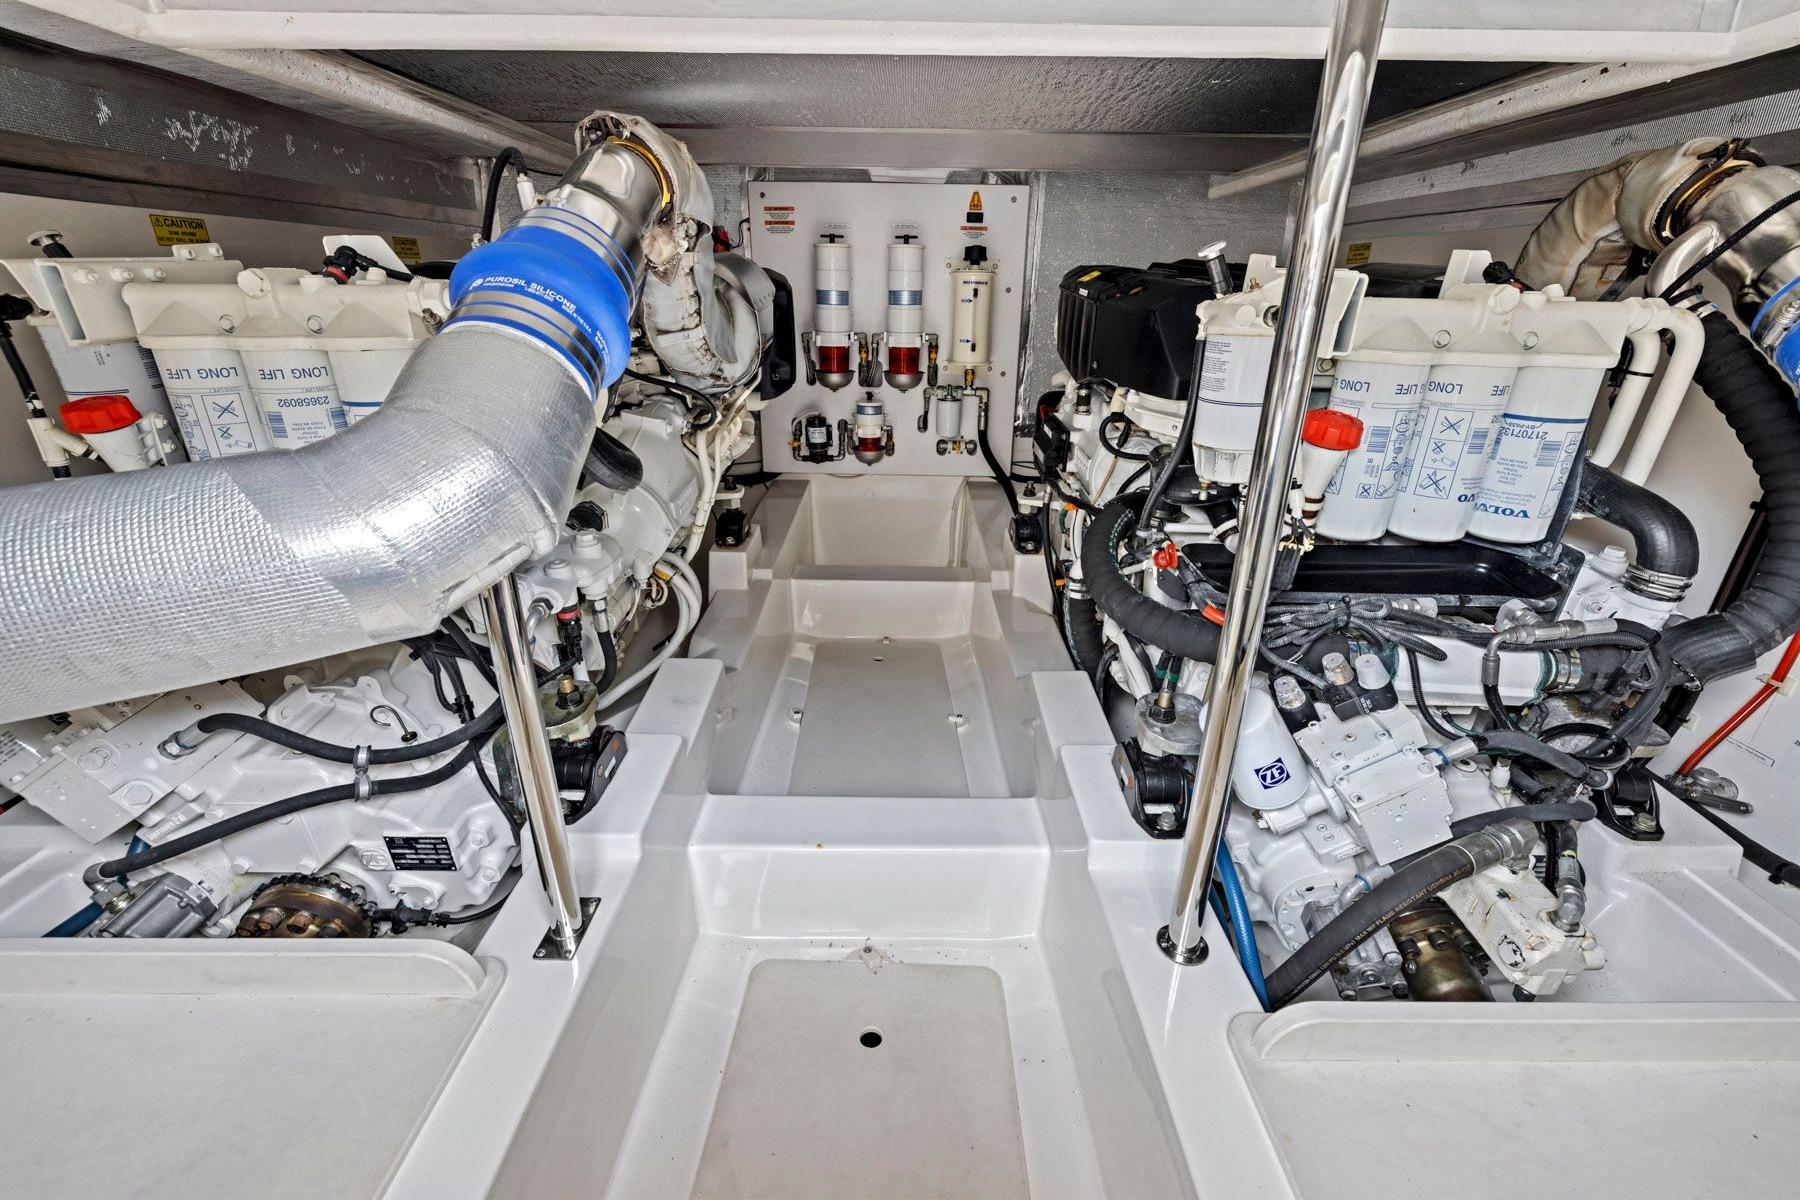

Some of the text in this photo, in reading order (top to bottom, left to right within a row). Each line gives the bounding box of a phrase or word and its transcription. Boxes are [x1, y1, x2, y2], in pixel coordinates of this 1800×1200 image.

[163, 218, 205, 230] CAUTION
[484, 276, 527, 287] PUROSIL
[530, 282, 576, 312] SILICONE
[166, 366, 238, 380] LONG LIFE
[259, 366, 329, 380] LONG LIFE
[1340, 379, 1370, 392] LONG
[1395, 384, 1417, 395] LIFE
[1428, 381, 1464, 394] LONG
[278, 395, 330, 408] 23658092
[1499, 426, 1549, 440] 21707132
[1259, 763, 1287, 786] ZF
[1394, 889, 1428, 912] RESISTANT
